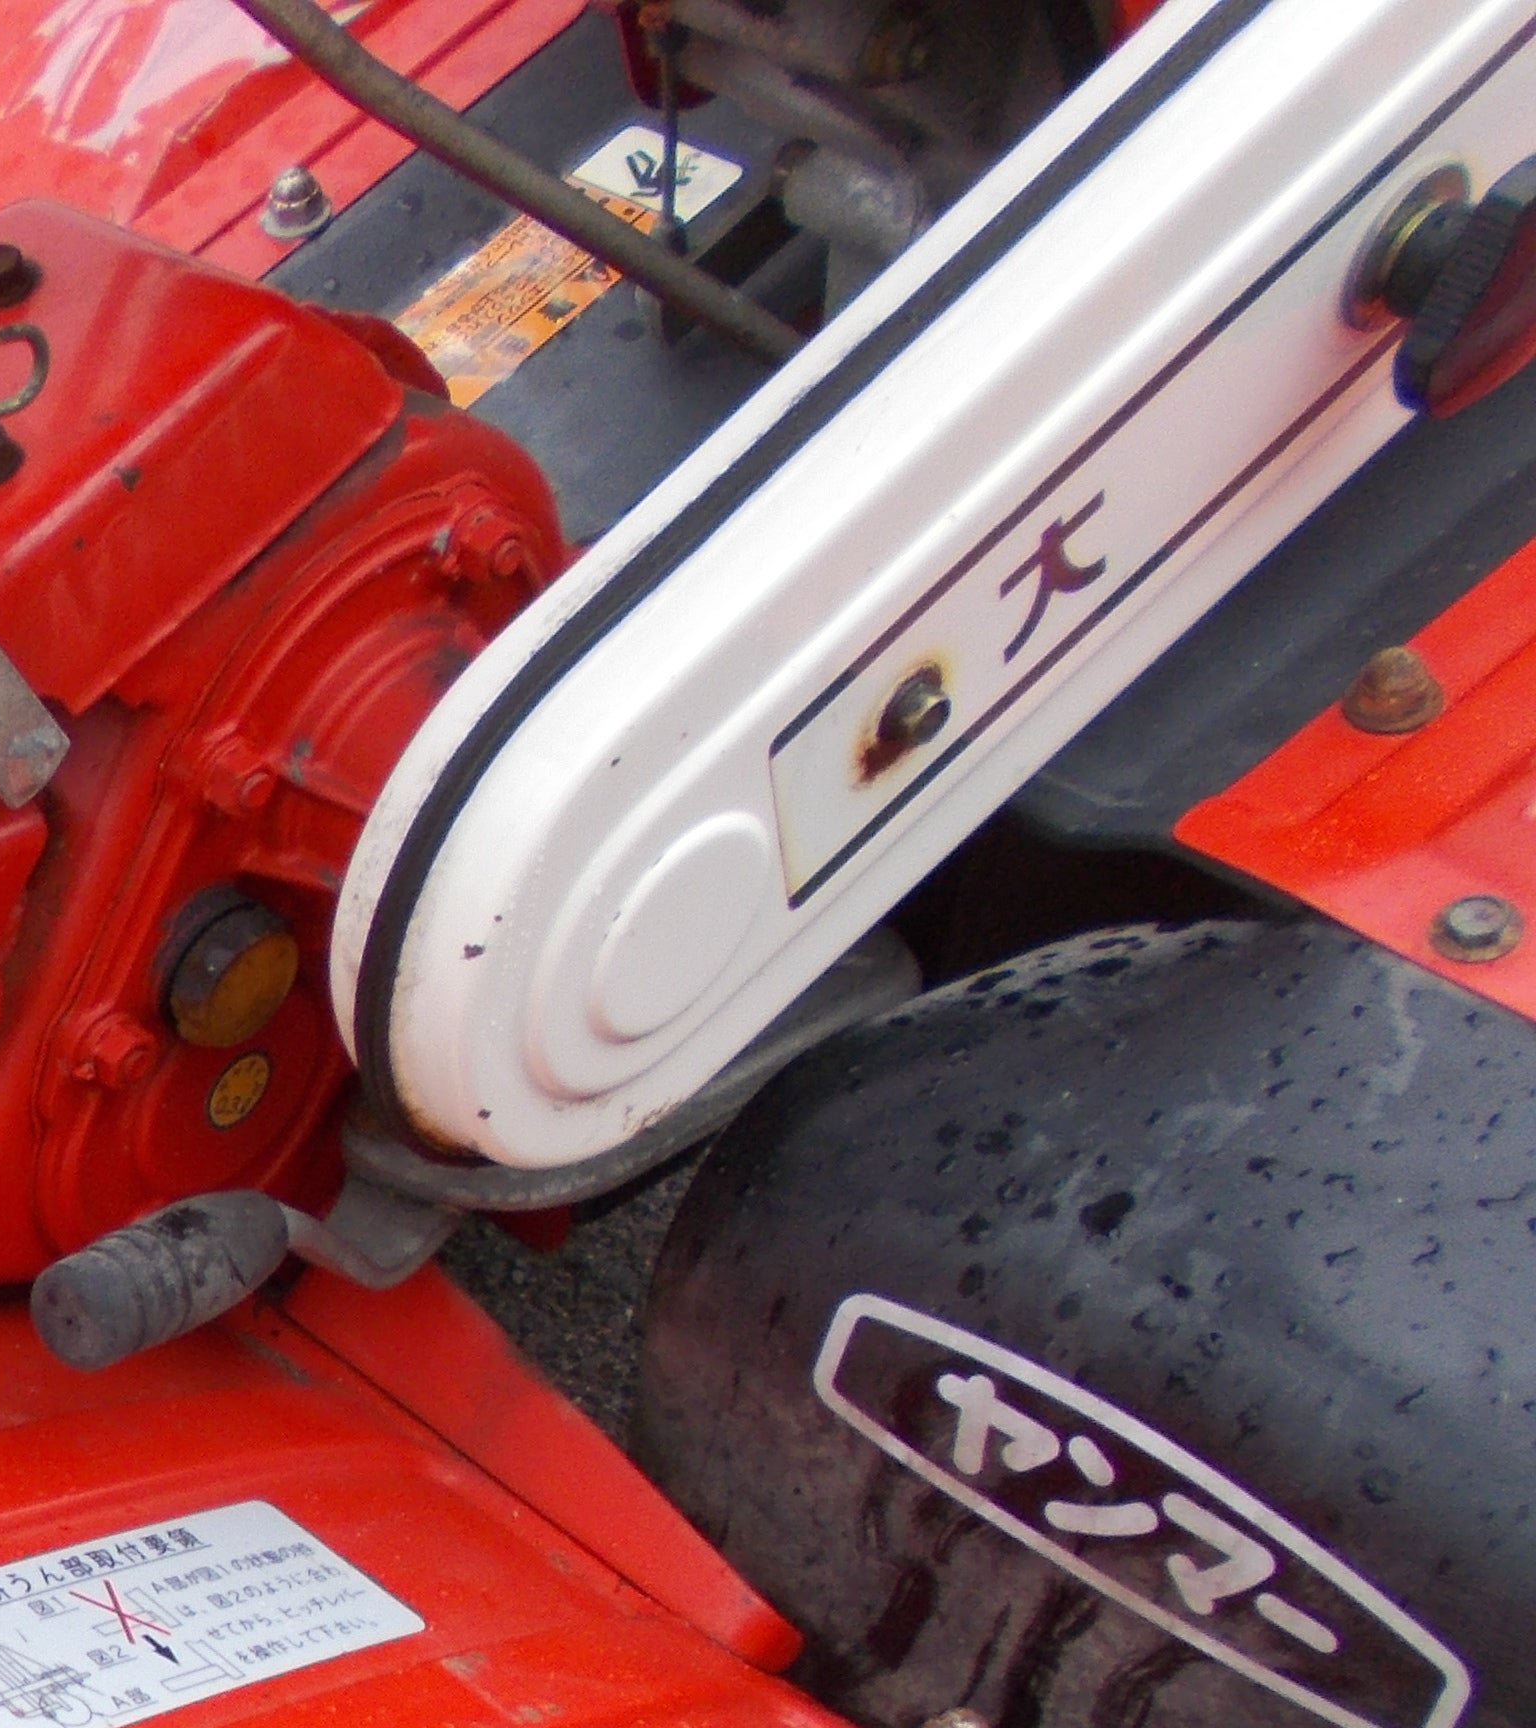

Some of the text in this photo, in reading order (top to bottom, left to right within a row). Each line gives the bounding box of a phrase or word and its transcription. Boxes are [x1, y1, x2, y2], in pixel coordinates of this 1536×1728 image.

[999, 489, 1107, 662] 大
[937, 1373, 1339, 1654] ヤンマー
